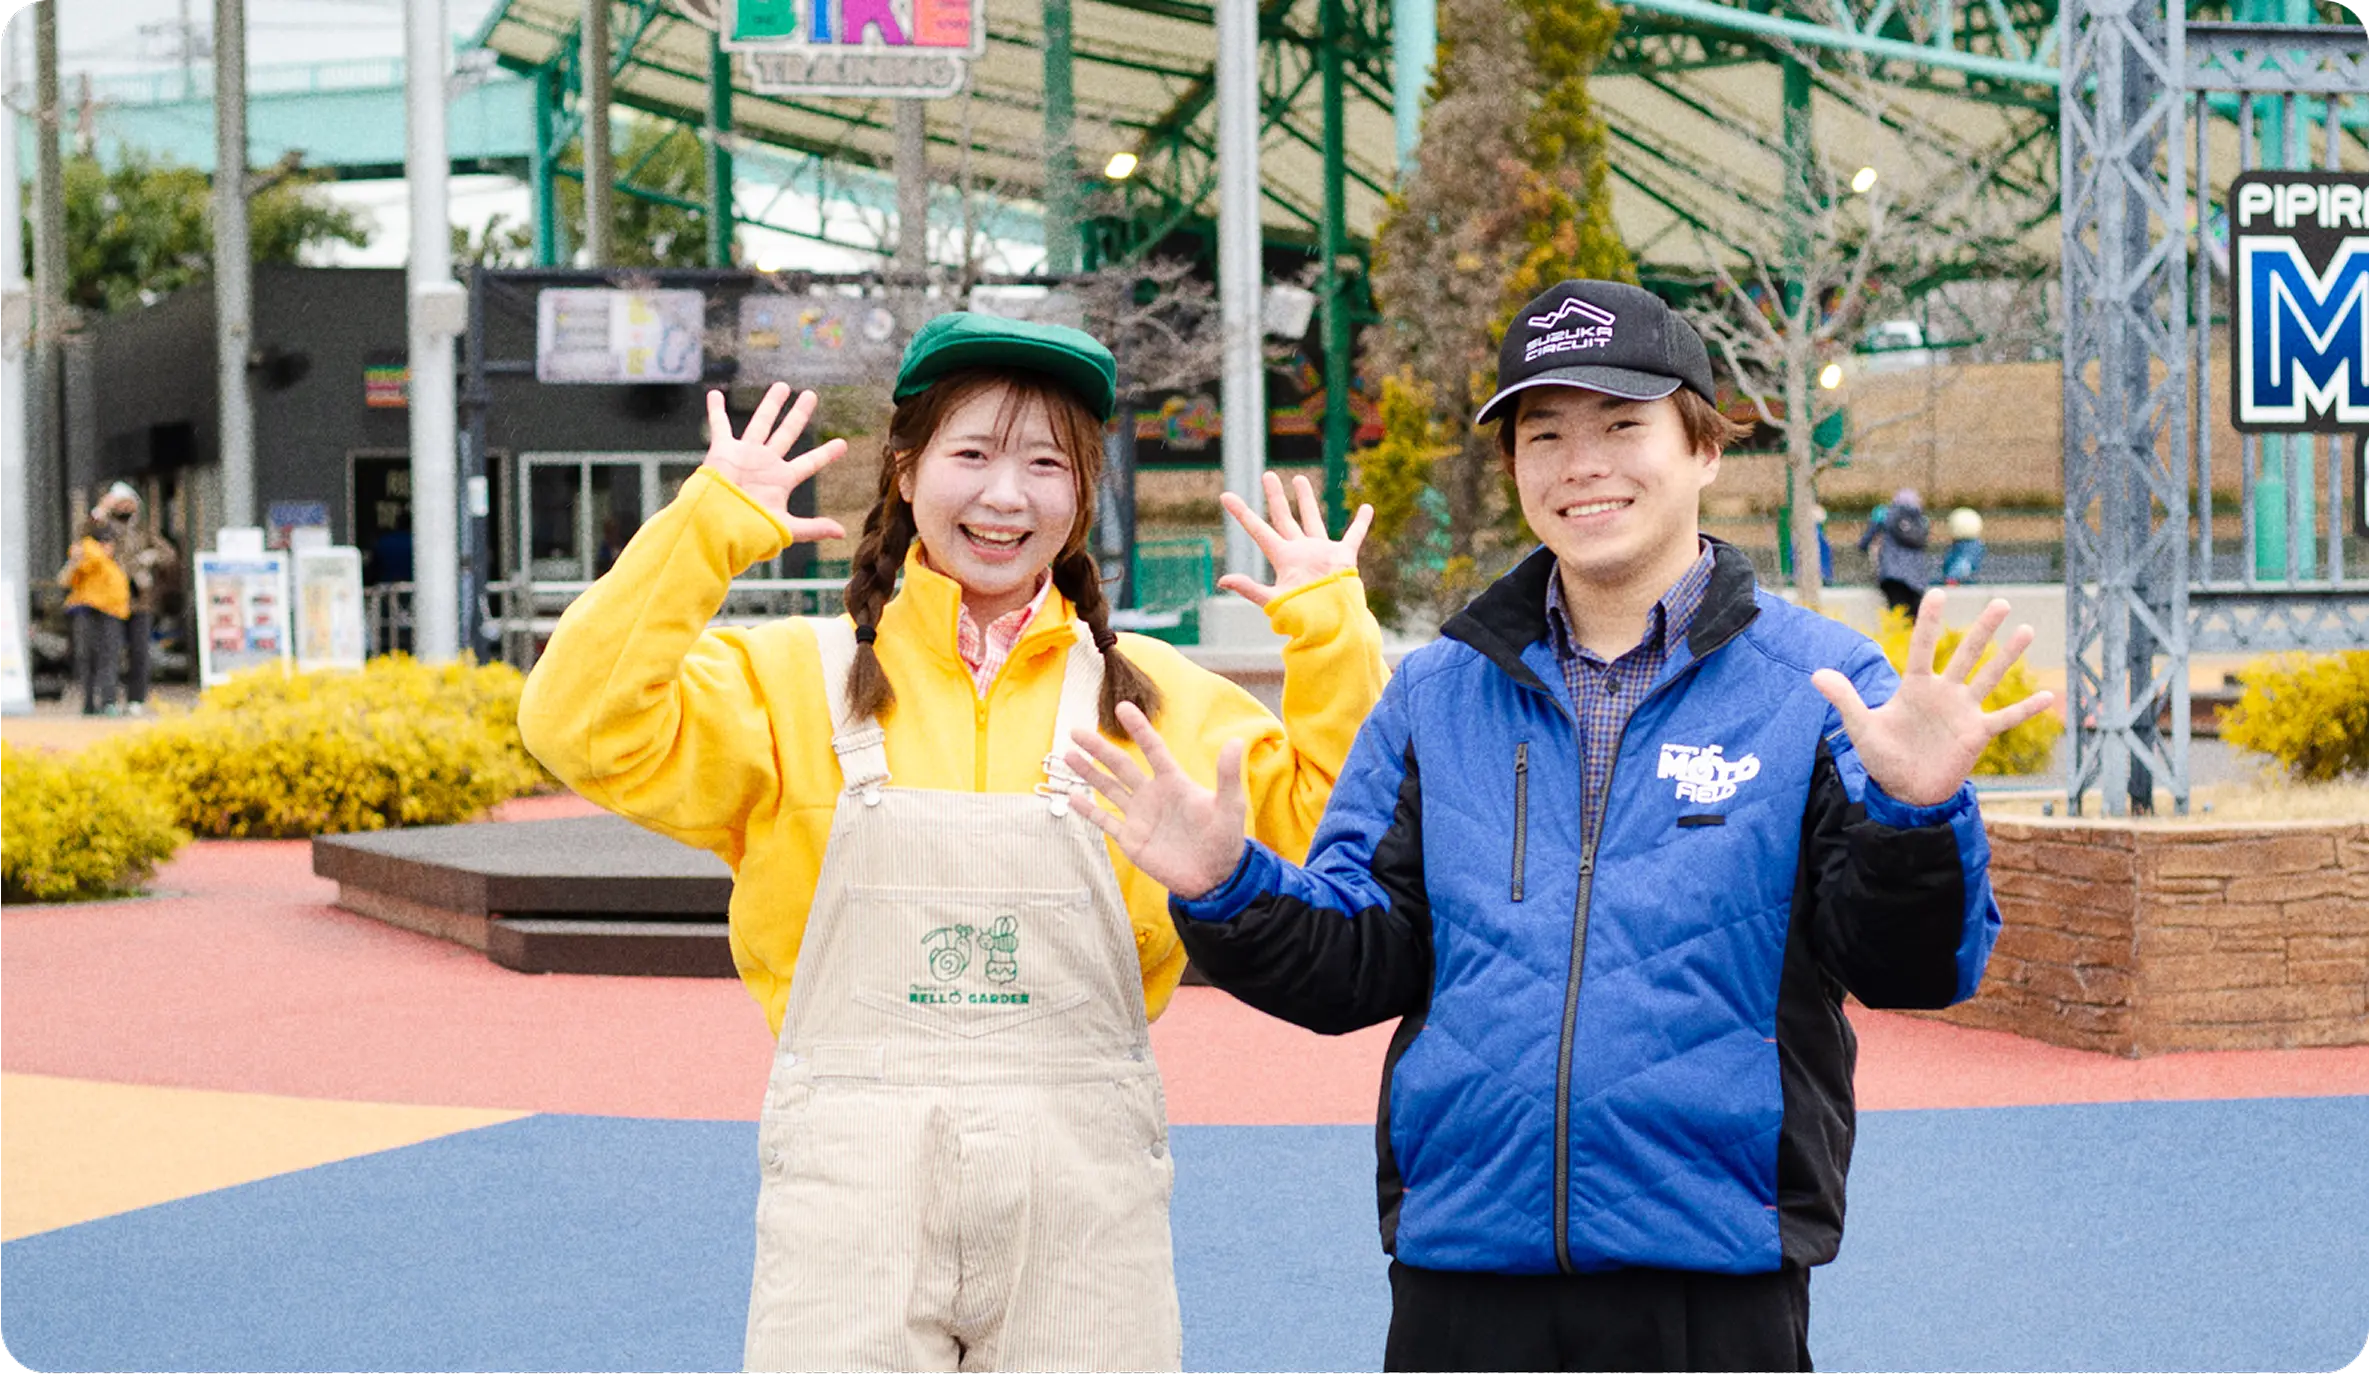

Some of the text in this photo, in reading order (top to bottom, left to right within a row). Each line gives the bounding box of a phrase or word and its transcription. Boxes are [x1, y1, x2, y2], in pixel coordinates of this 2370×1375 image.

[755, 54, 954, 87] TRAINING
[1524, 337, 1612, 362] CIRCUIT
[1526, 326, 1613, 352] SUZUKA
[1657, 749, 1760, 784] MOTO
[1675, 781, 1737, 804] FIELD
[968, 993, 1029, 1004] GARDEN
